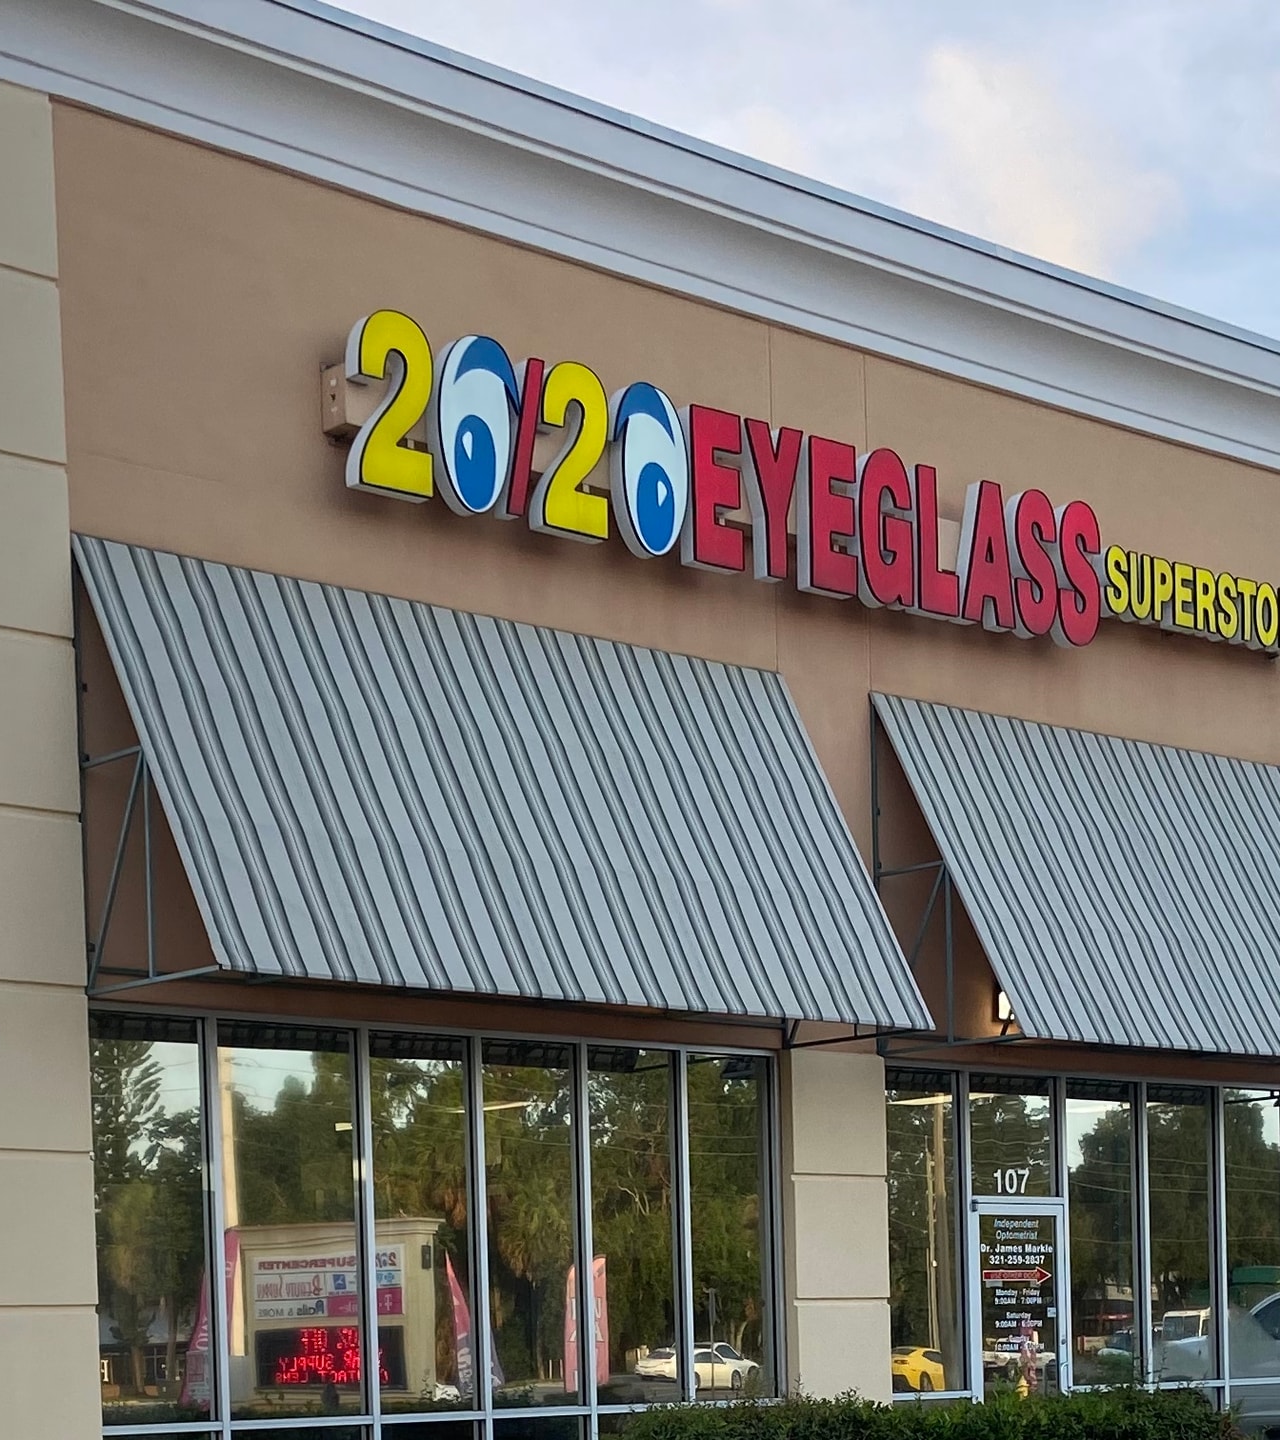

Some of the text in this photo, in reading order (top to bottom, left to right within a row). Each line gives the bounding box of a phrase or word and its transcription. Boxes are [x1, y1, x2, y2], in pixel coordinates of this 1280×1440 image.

[356, 308, 687, 559] 20/20
[689, 404, 1100, 647] EYEGLASS
[992, 1168, 1030, 1194] 107
[994, 1218, 1039, 1229] Independent
[995, 1230, 1038, 1240] Optometrist
[981, 1244, 993, 1253] Dr.
[995, 1244, 1023, 1253] James
